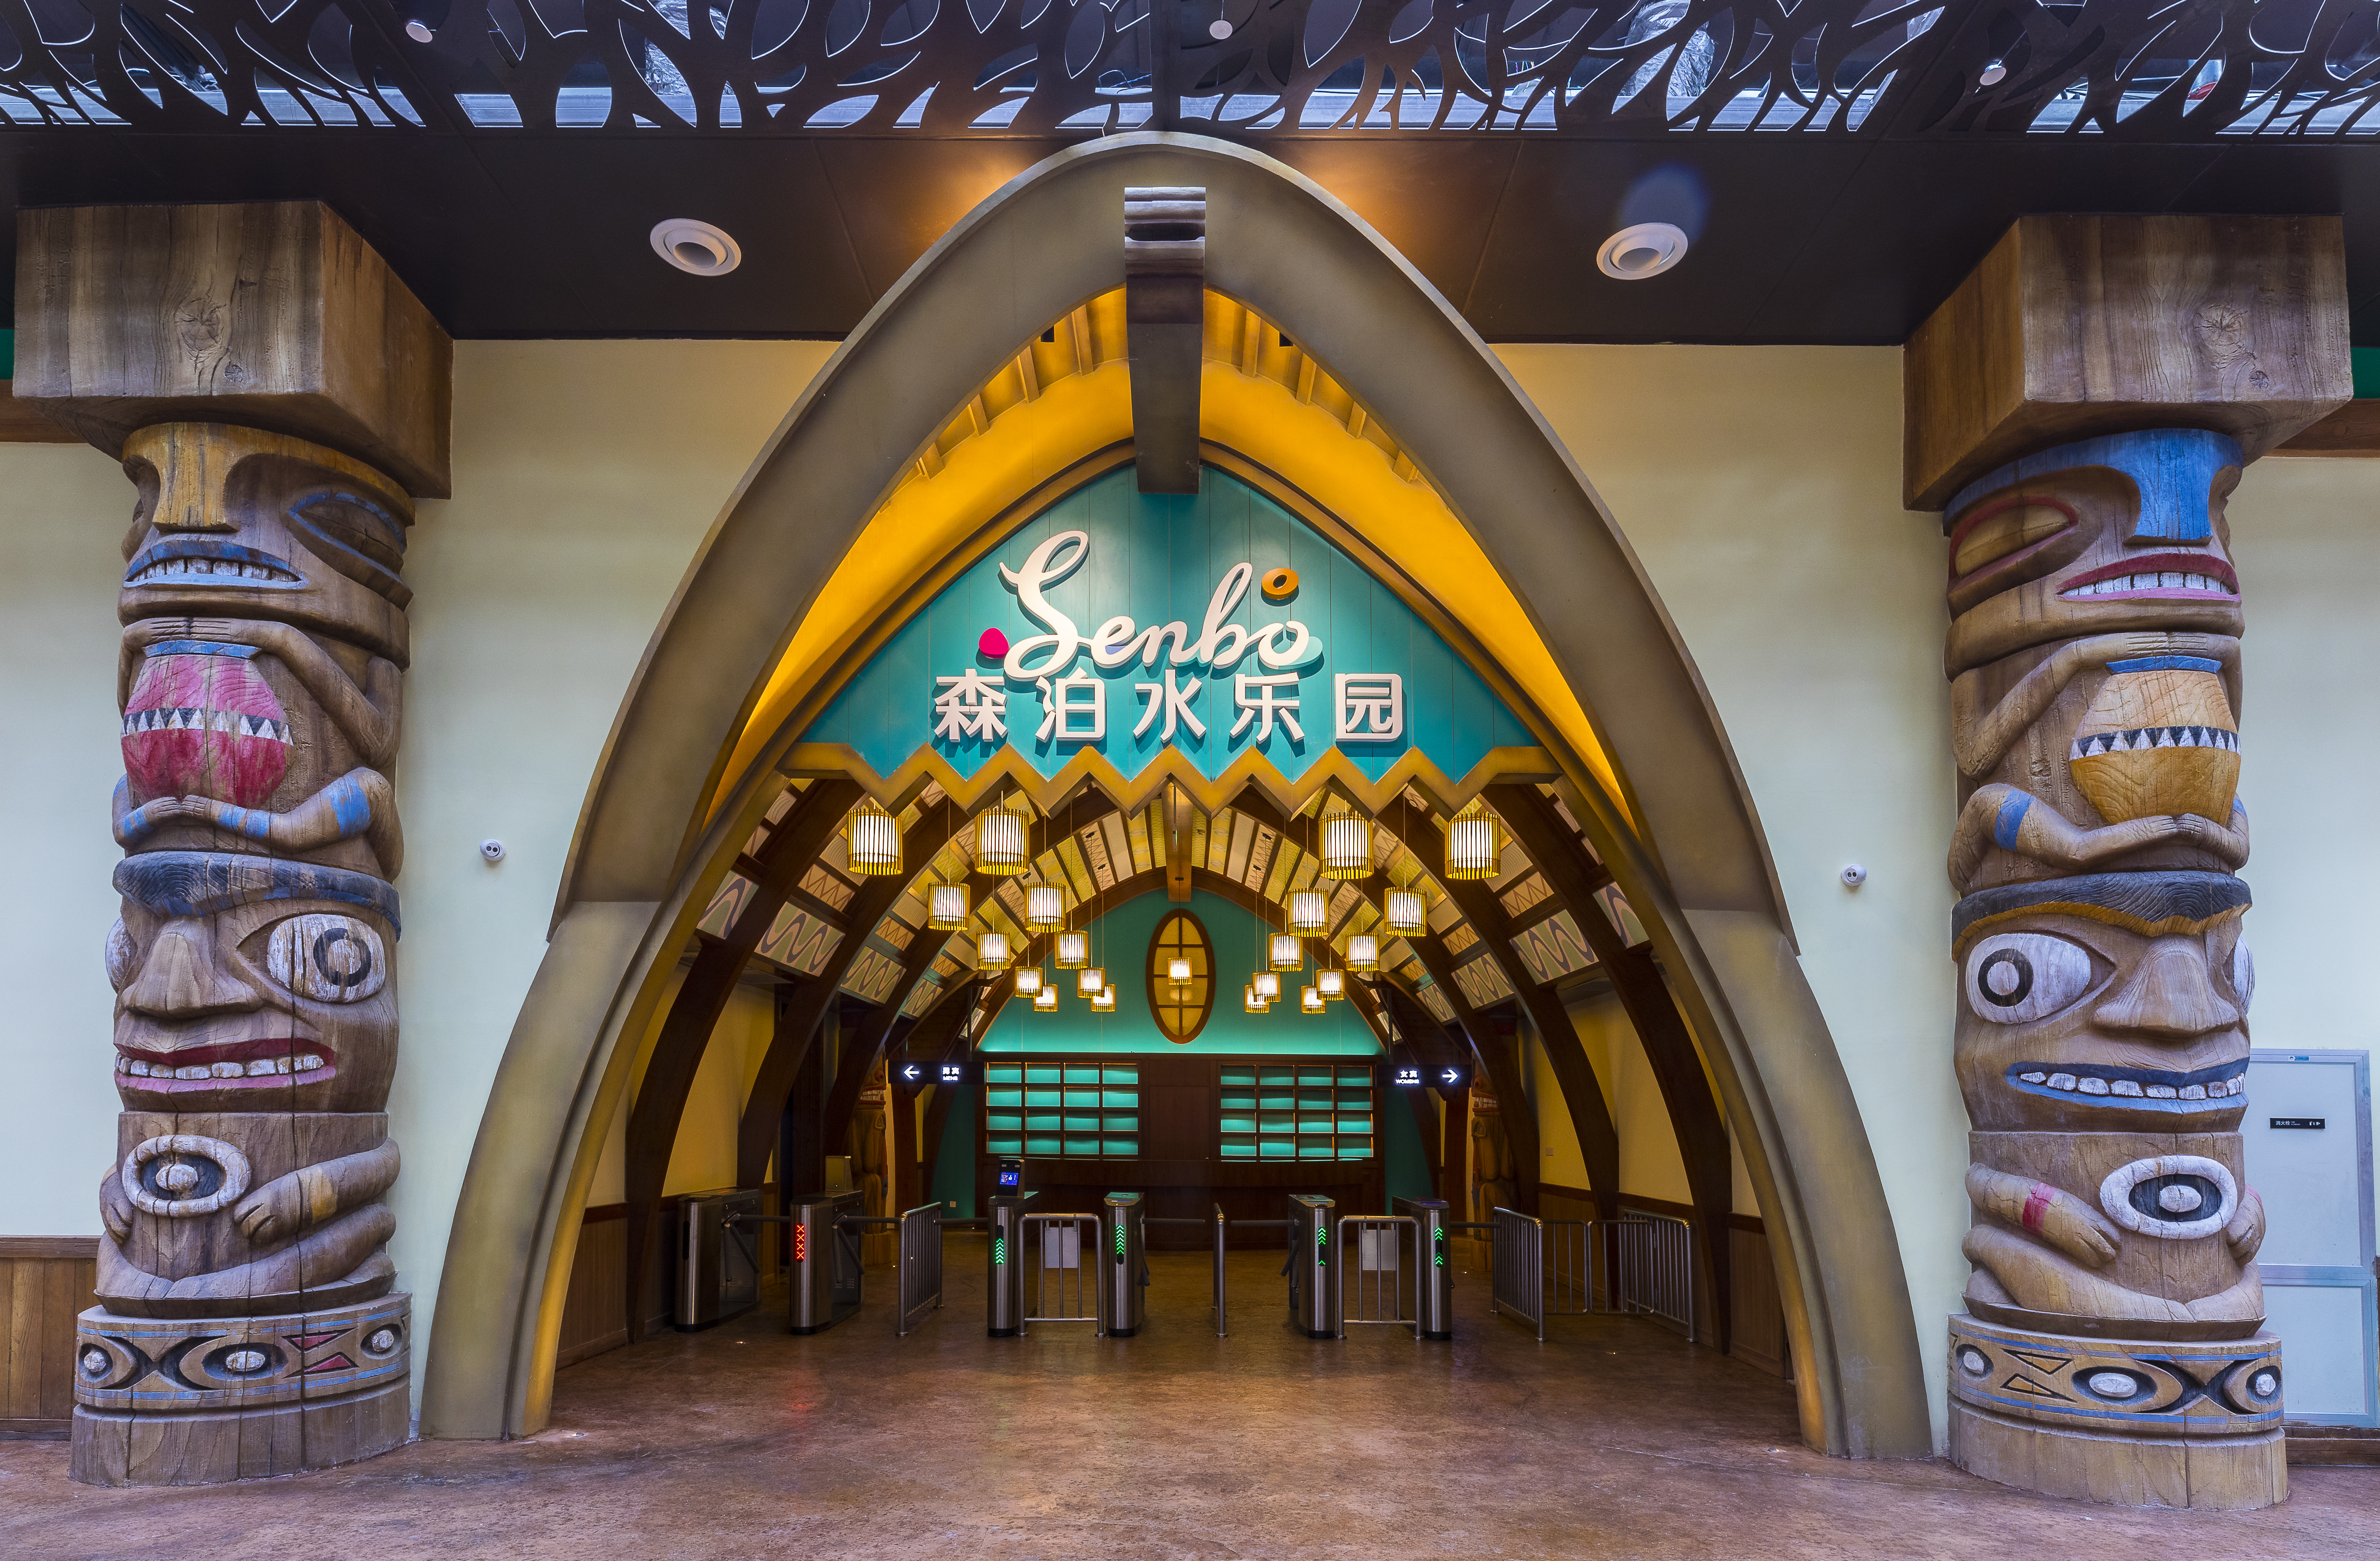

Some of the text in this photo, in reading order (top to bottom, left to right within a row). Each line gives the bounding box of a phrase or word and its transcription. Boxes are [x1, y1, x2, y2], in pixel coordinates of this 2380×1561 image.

[999, 530, 1312, 681] Senbo
[934, 668, 1403, 743] 森泊水乐园
